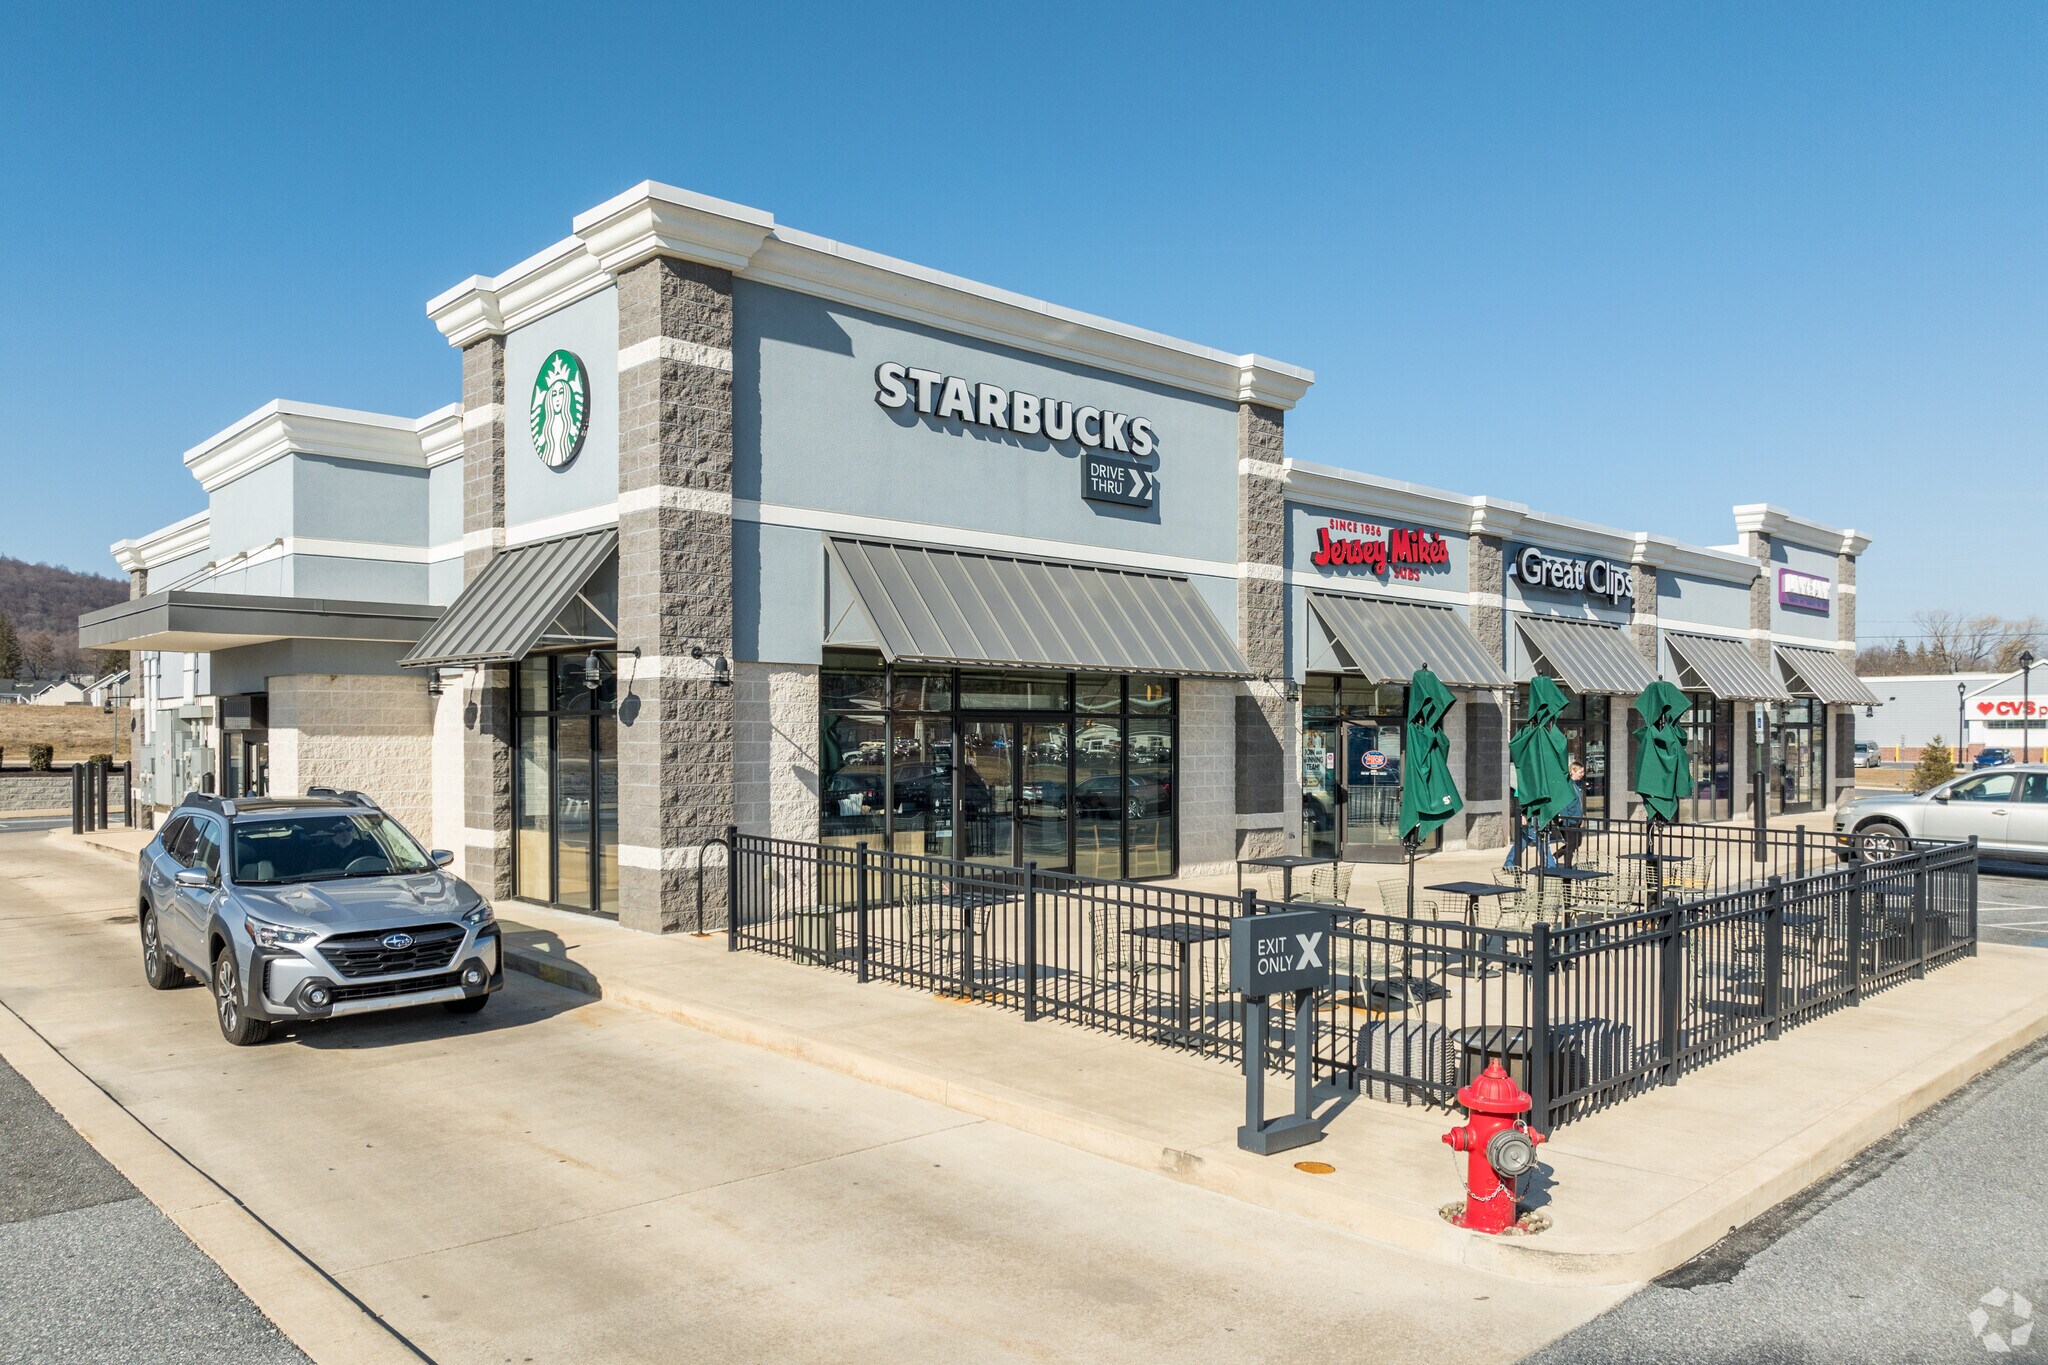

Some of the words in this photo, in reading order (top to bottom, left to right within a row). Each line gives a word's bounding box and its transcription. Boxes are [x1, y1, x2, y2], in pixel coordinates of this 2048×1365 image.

[875, 361, 1153, 456] STARBUCKS
[1090, 462, 1125, 481] DRIVE
[1090, 477, 1123, 495] THRU
[1329, 518, 1357, 533] SINCE
[1361, 523, 1382, 537] 1956
[1312, 527, 1387, 575] Jersey
[1517, 547, 1584, 590] Great
[1586, 558, 1633, 606] Clips
[1996, 701, 2036, 716] CVS
[1257, 936, 1287, 956] EXIT
[1257, 955, 1293, 976] ONLY
